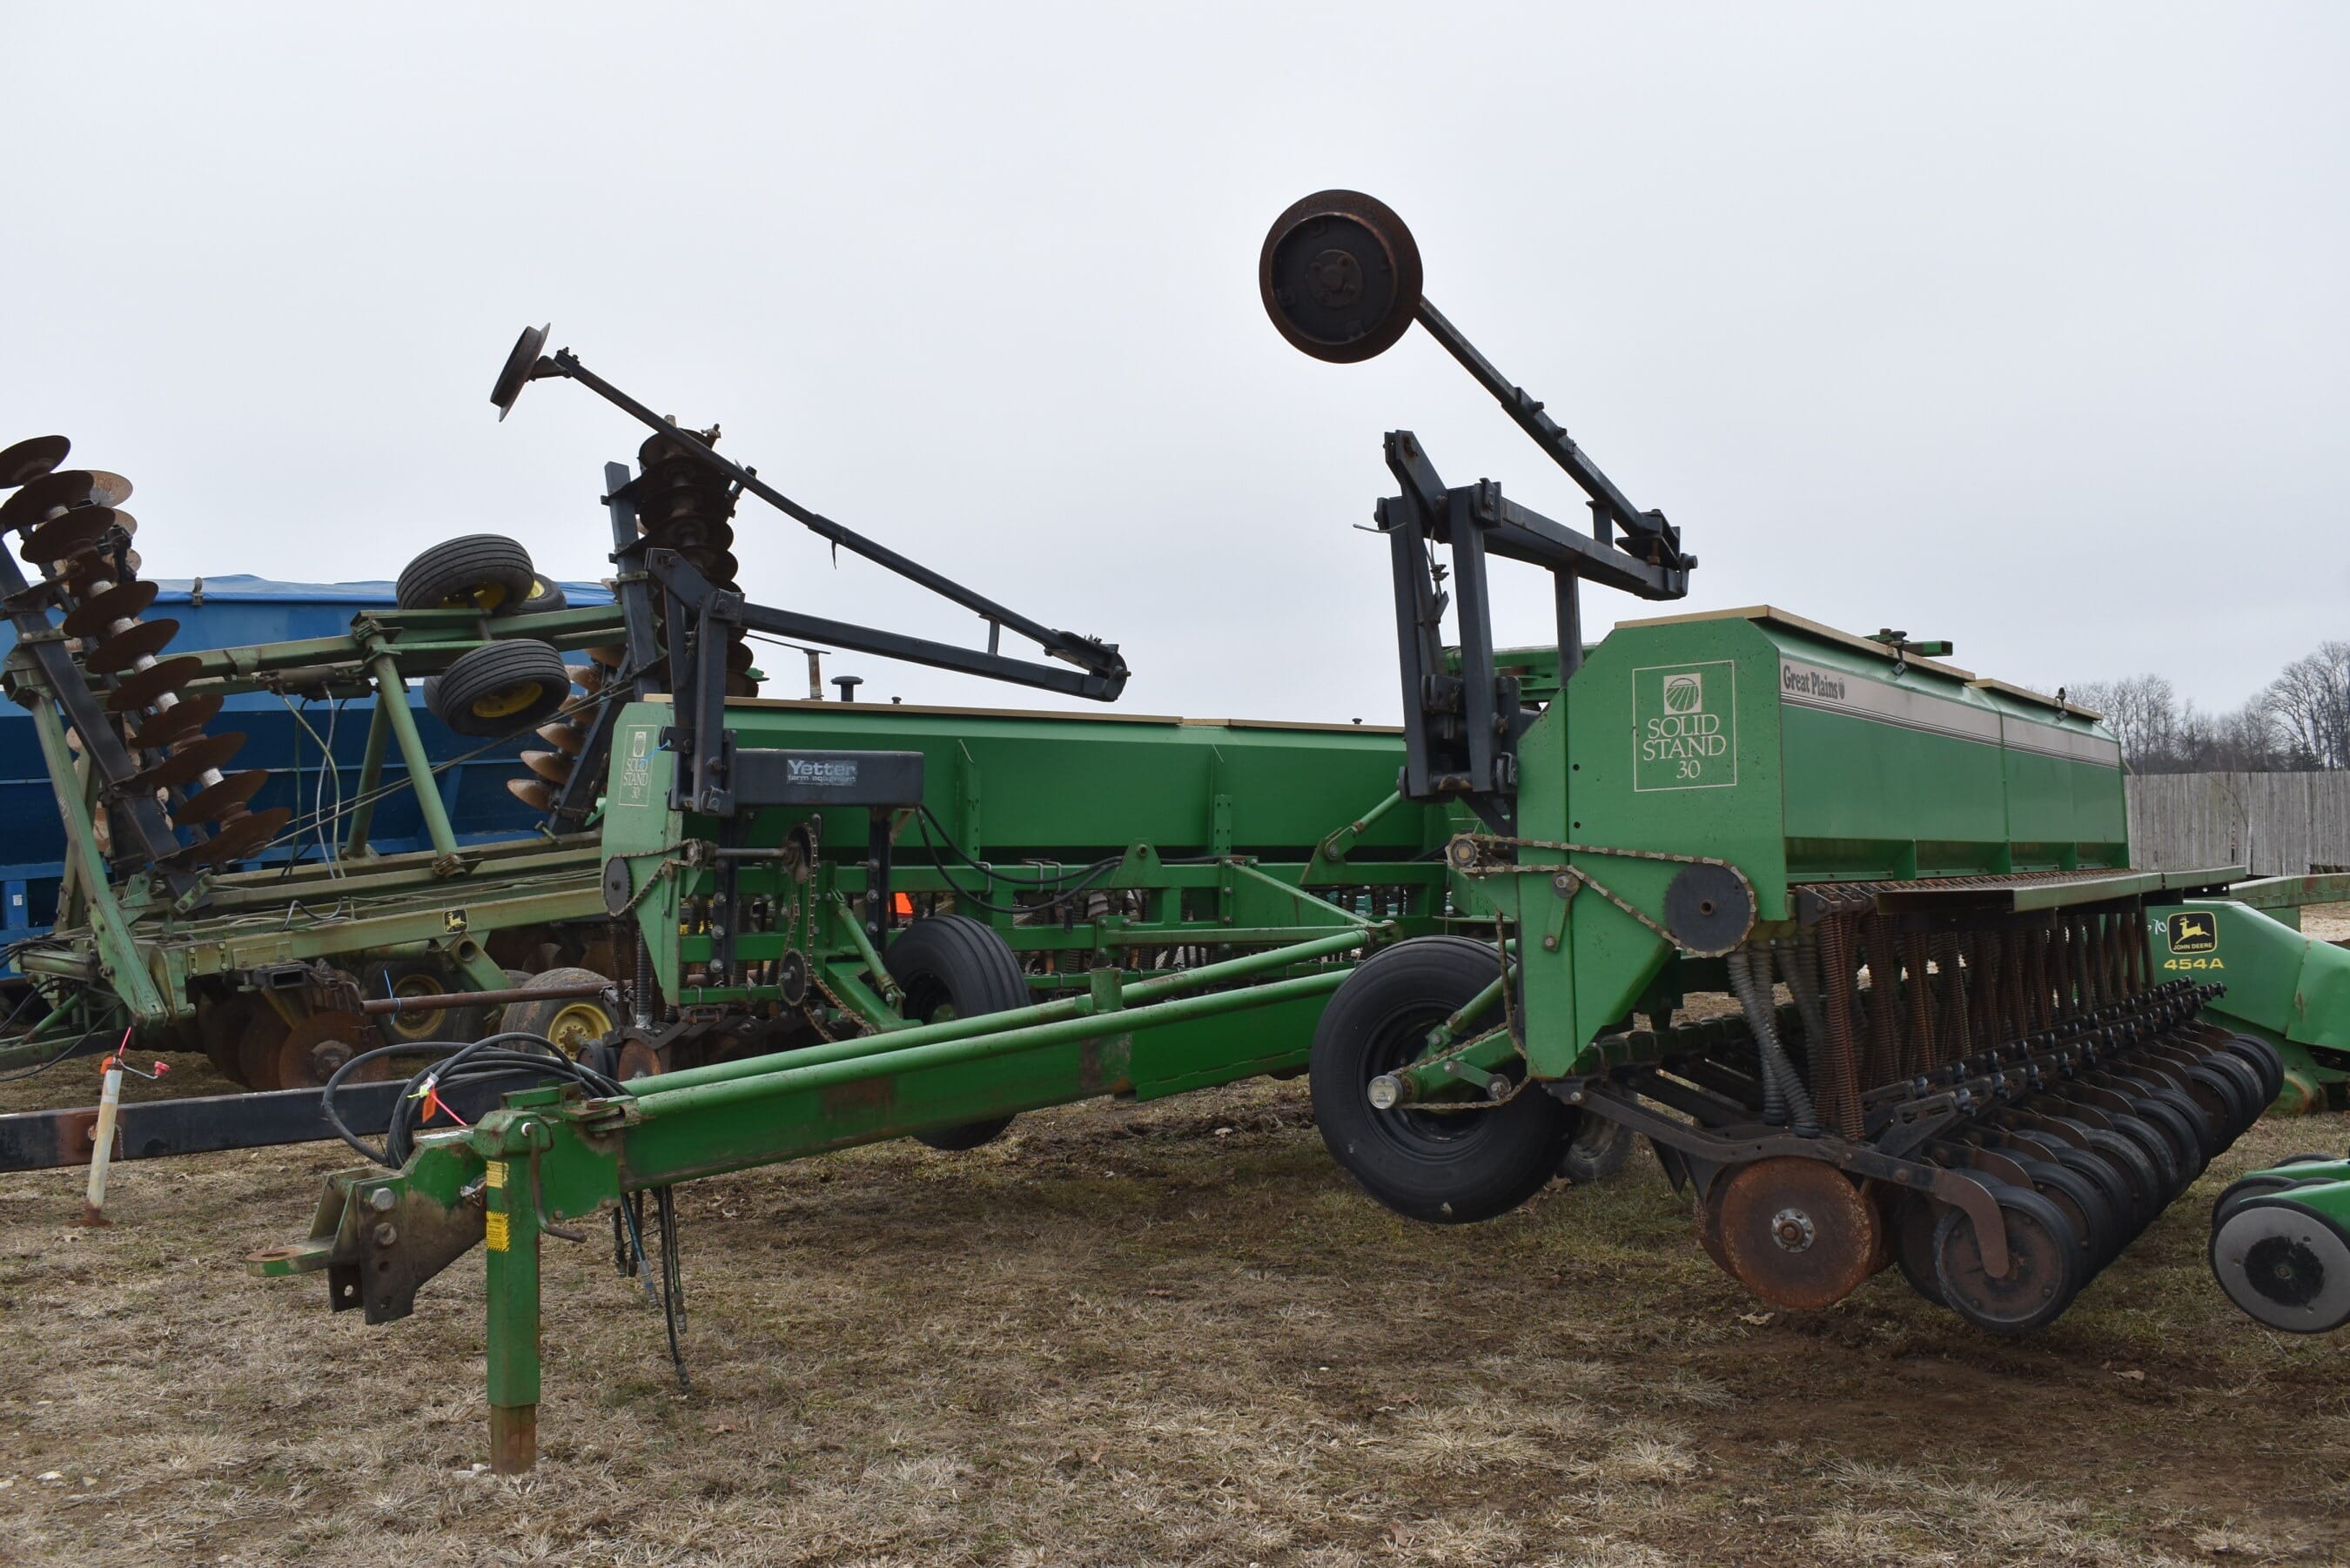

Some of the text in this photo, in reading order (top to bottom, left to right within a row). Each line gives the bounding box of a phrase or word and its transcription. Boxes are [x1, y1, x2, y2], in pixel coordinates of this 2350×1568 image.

[1783, 664, 1839, 700] Great Plains
[1648, 714, 1721, 740] SOLID
[1642, 734, 1727, 761] STAND
[787, 759, 856, 775] Yetter
[1676, 760, 1701, 779] 30
[623, 772, 648, 786] STAND
[2164, 958, 2225, 970] 454A
